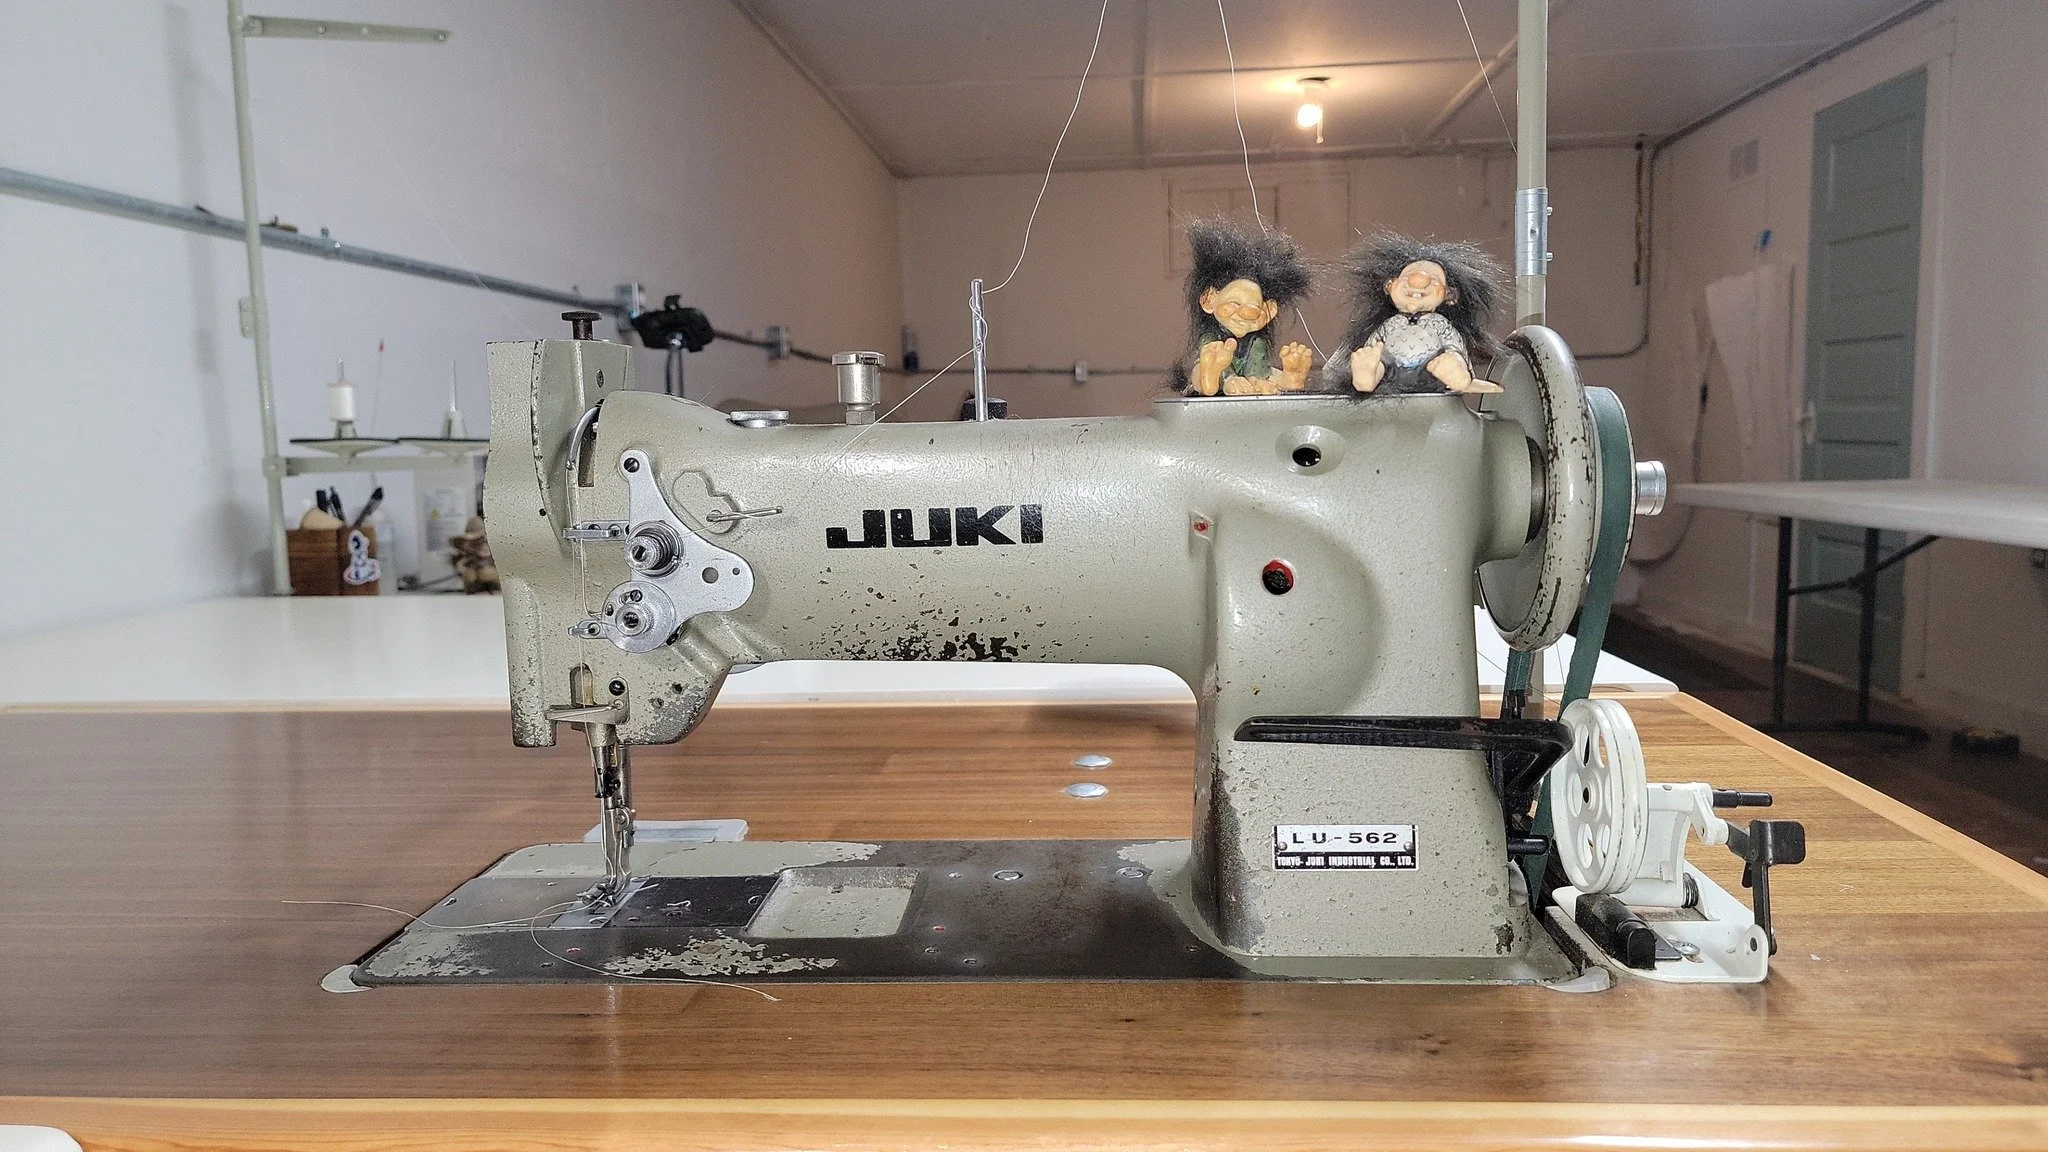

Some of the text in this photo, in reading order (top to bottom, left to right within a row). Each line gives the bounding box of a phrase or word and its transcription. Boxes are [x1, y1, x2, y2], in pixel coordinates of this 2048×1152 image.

[826, 504, 1043, 548] JUKI
[1306, 856, 1324, 866] JUKI
[1329, 856, 1375, 866] INDUSTRIAL
